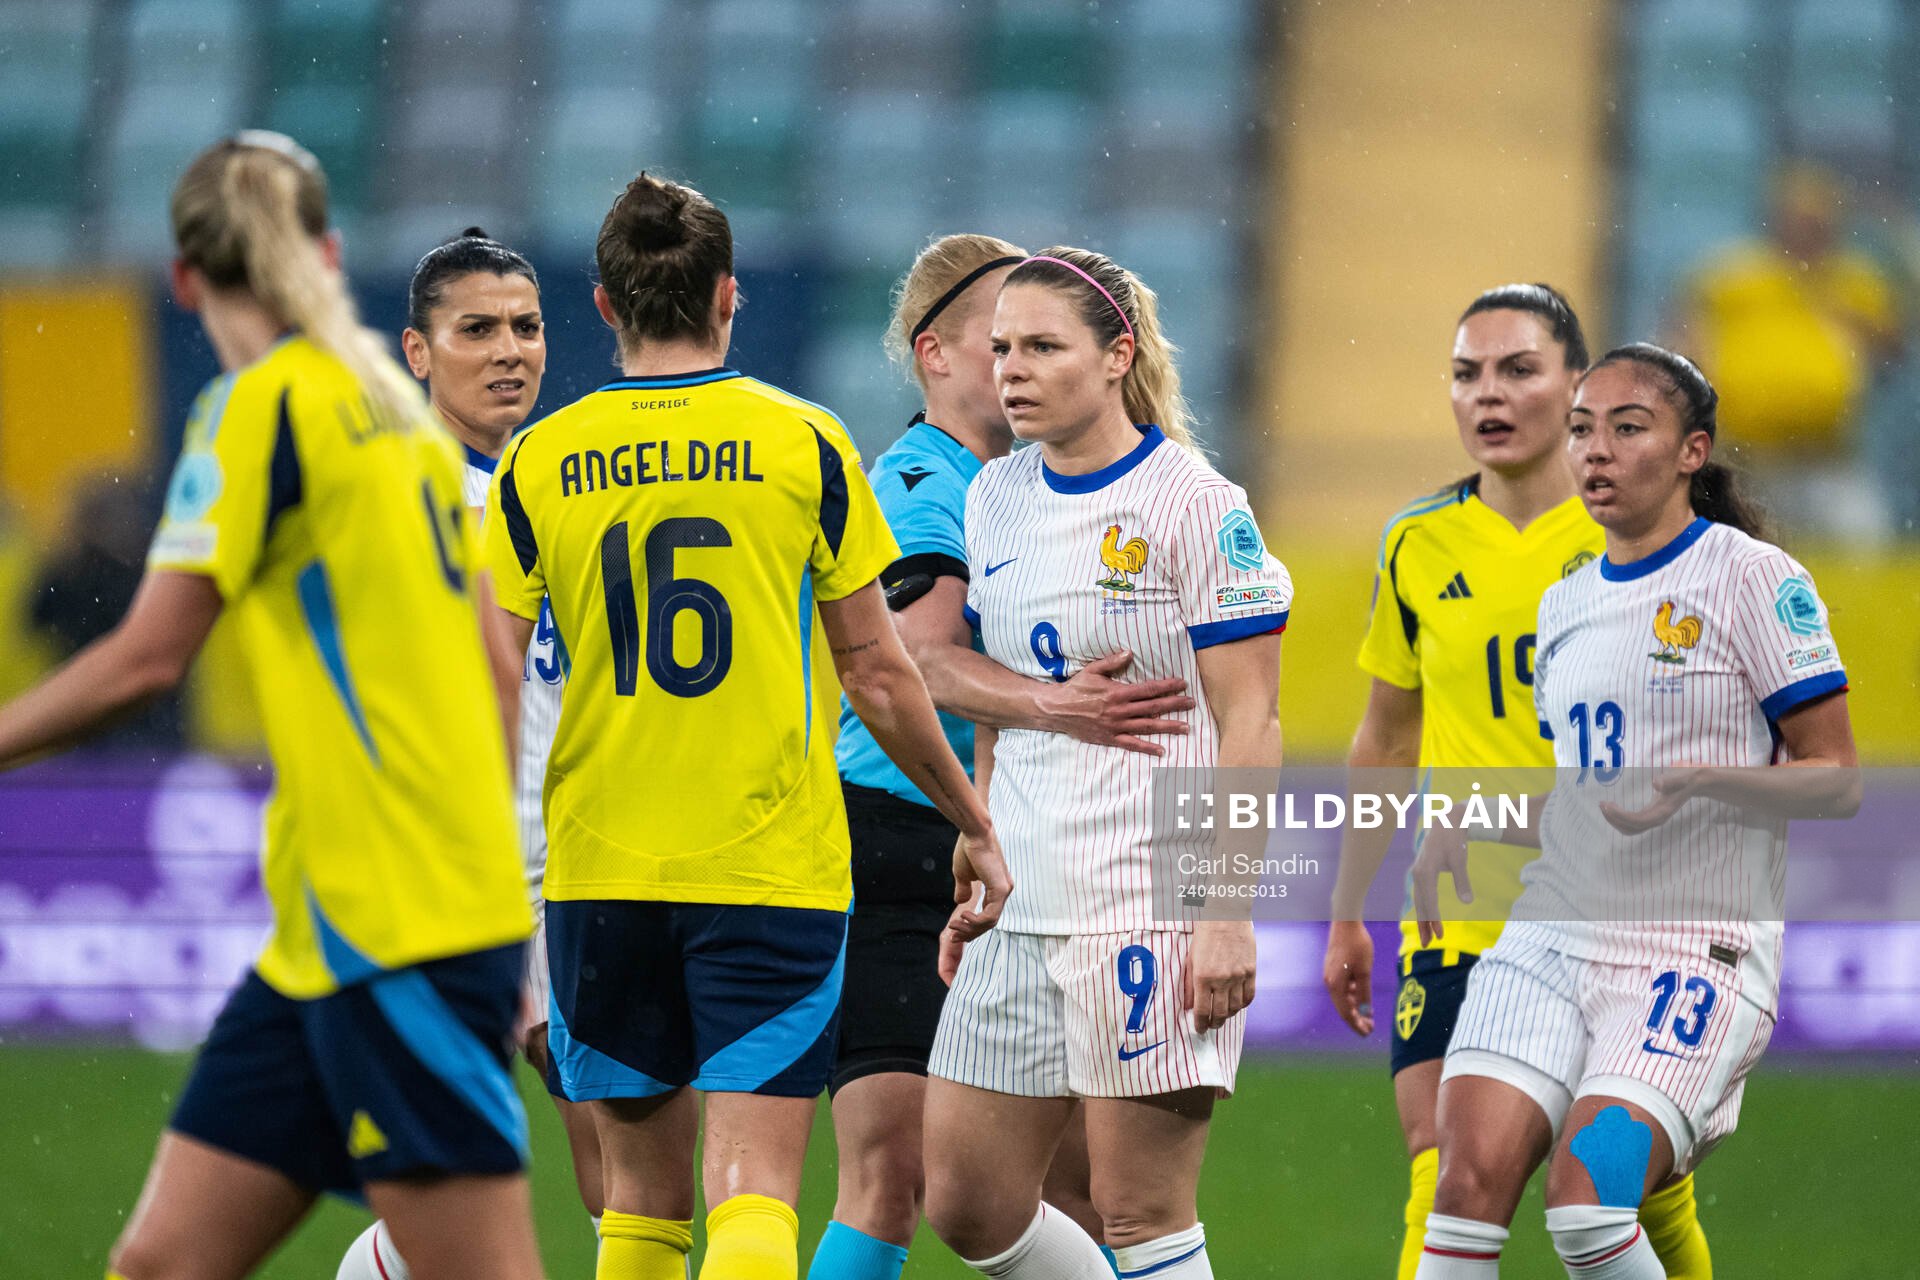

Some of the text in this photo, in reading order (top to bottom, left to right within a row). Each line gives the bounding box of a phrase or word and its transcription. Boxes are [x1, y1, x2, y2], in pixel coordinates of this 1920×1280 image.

[631, 397, 690, 410] SVERIGE
[560, 440, 764, 497] ANGELDAL
[522, 596, 562, 685] 5
[601, 516, 733, 698] 16
[1030, 621, 1069, 683] 9
[1569, 701, 1625, 787] 13
[1117, 944, 1158, 1034] 9
[1646, 970, 1717, 1051] 13
